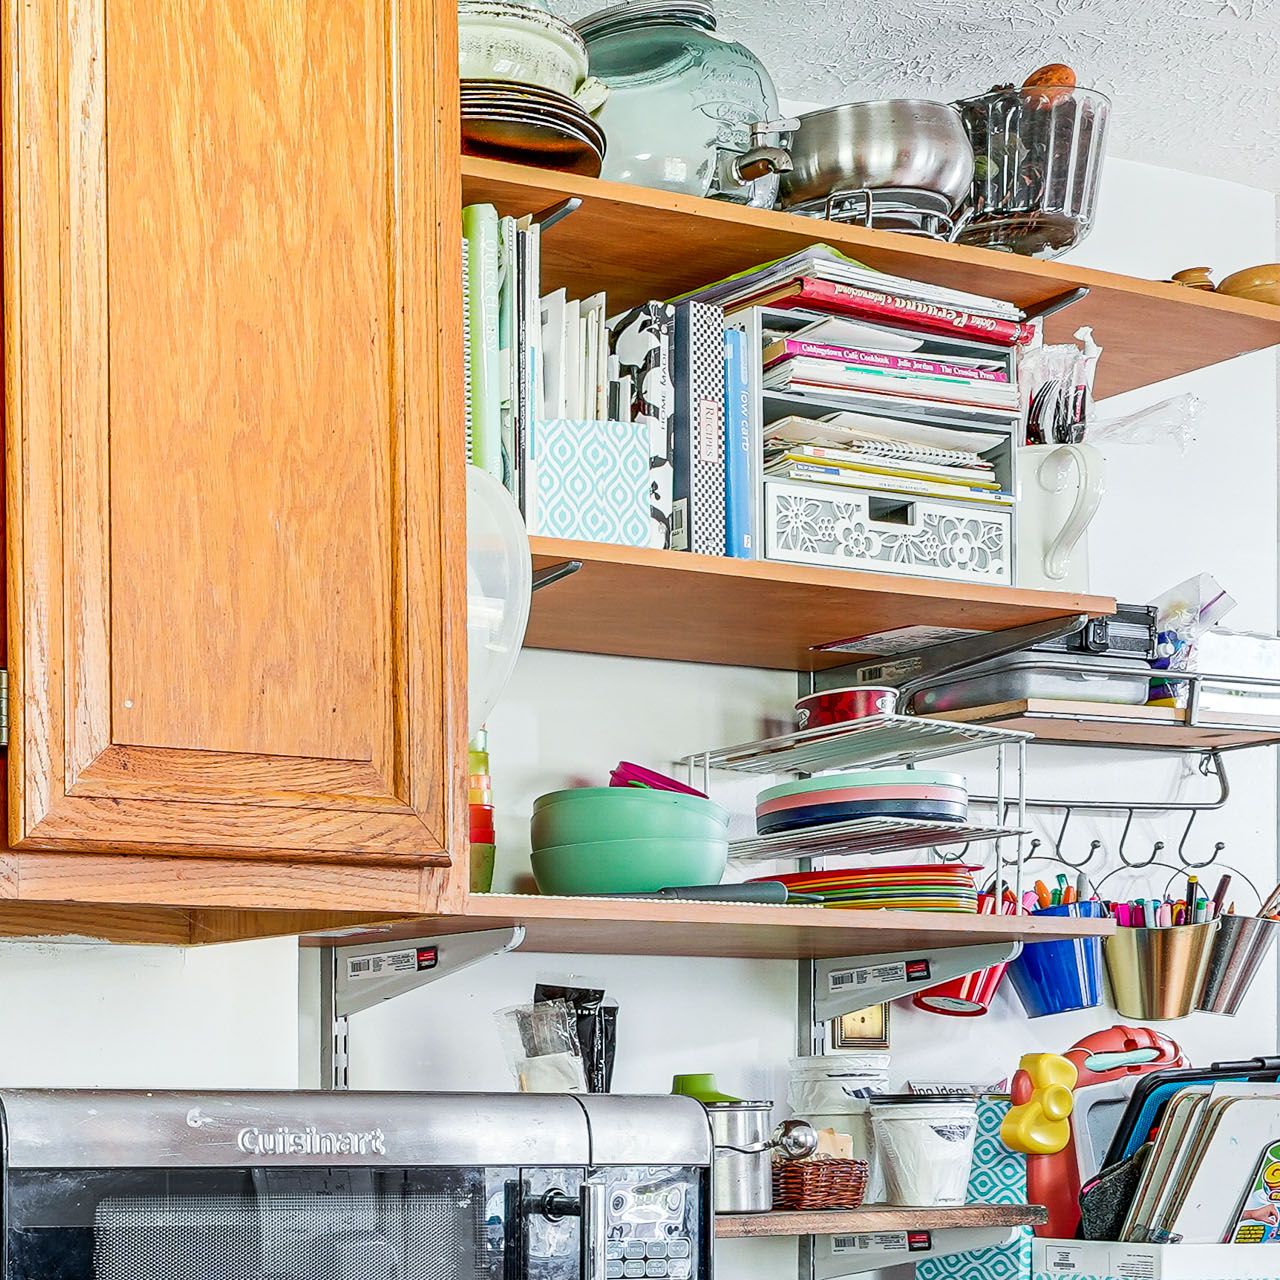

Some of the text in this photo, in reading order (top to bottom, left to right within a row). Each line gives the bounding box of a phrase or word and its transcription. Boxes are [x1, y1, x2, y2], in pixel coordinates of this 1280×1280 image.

[895, 297, 968, 327] Peruana
[970, 317, 997, 331] Cocina
[859, 353, 890, 365] Cookbook
[913, 361, 934, 371] Jordan
[940, 364, 951, 373] The
[706, 406, 715, 458] RECIPES
[740, 390, 750, 452] low carb
[237, 1126, 386, 1155] Cuisinart
